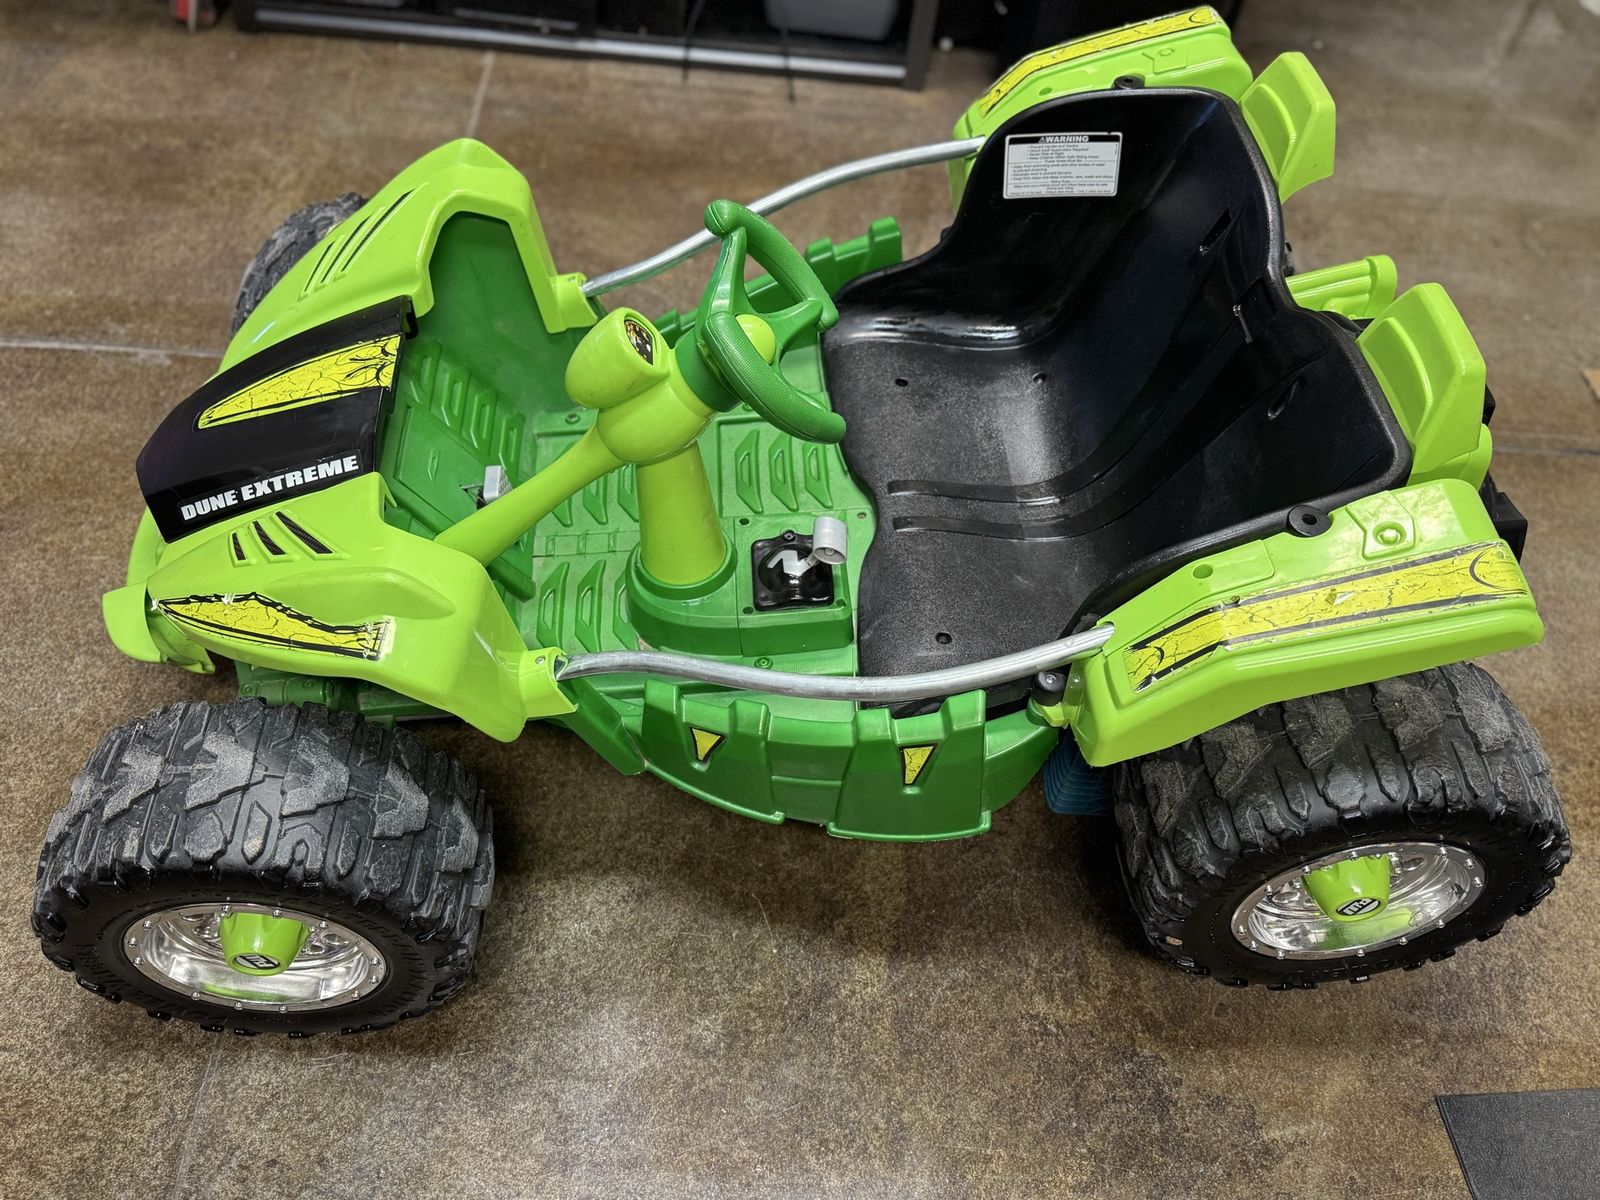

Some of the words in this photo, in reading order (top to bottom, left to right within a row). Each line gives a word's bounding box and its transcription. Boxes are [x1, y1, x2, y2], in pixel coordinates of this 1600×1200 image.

[1046, 135, 1089, 143] WARNING
[180, 489, 239, 521] DUNE
[241, 455, 359, 501] EXTREME
